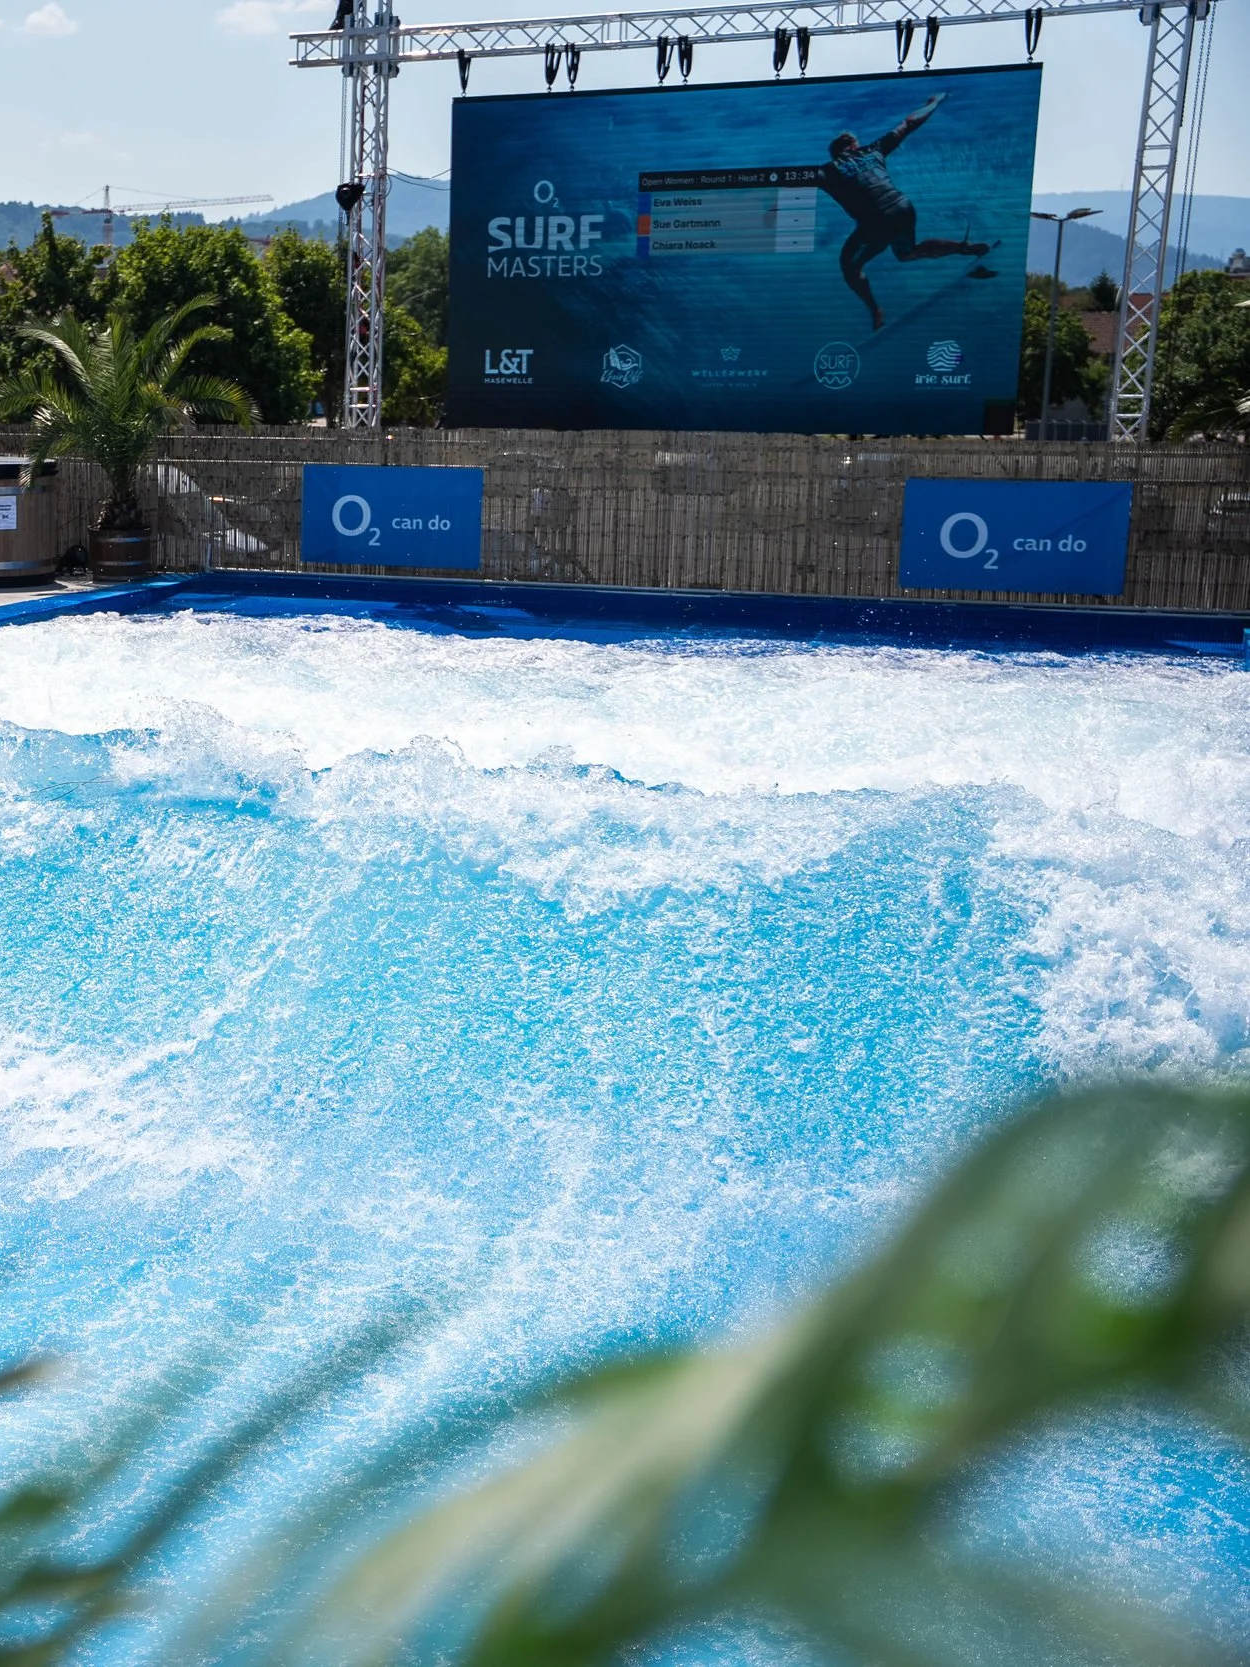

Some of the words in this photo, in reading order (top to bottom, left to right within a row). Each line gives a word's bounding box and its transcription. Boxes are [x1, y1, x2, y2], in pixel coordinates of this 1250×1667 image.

[641, 178, 663, 187] Open
[665, 177, 695, 186] Women
[701, 175, 726, 184] Round
[738, 174, 758, 182] Heat
[784, 171, 816, 181] 13:34
[653, 198, 673, 207] Eva
[674, 197, 703, 207] Weiss
[652, 220, 671, 229] Sue
[673, 219, 721, 229] Gartmann
[487, 214, 605, 253] SURF
[652, 241, 683, 250] Chiara
[685, 239, 716, 249] Noack
[487, 255, 603, 278] MASTERS
[485, 349, 533, 374] L&T
[819, 354, 855, 369] SURF
[915, 374, 937, 384] irie
[391, 517, 423, 530] can
[427, 515, 451, 531] do
[1013, 537, 1052, 551] can
[1058, 534, 1087, 552] do
